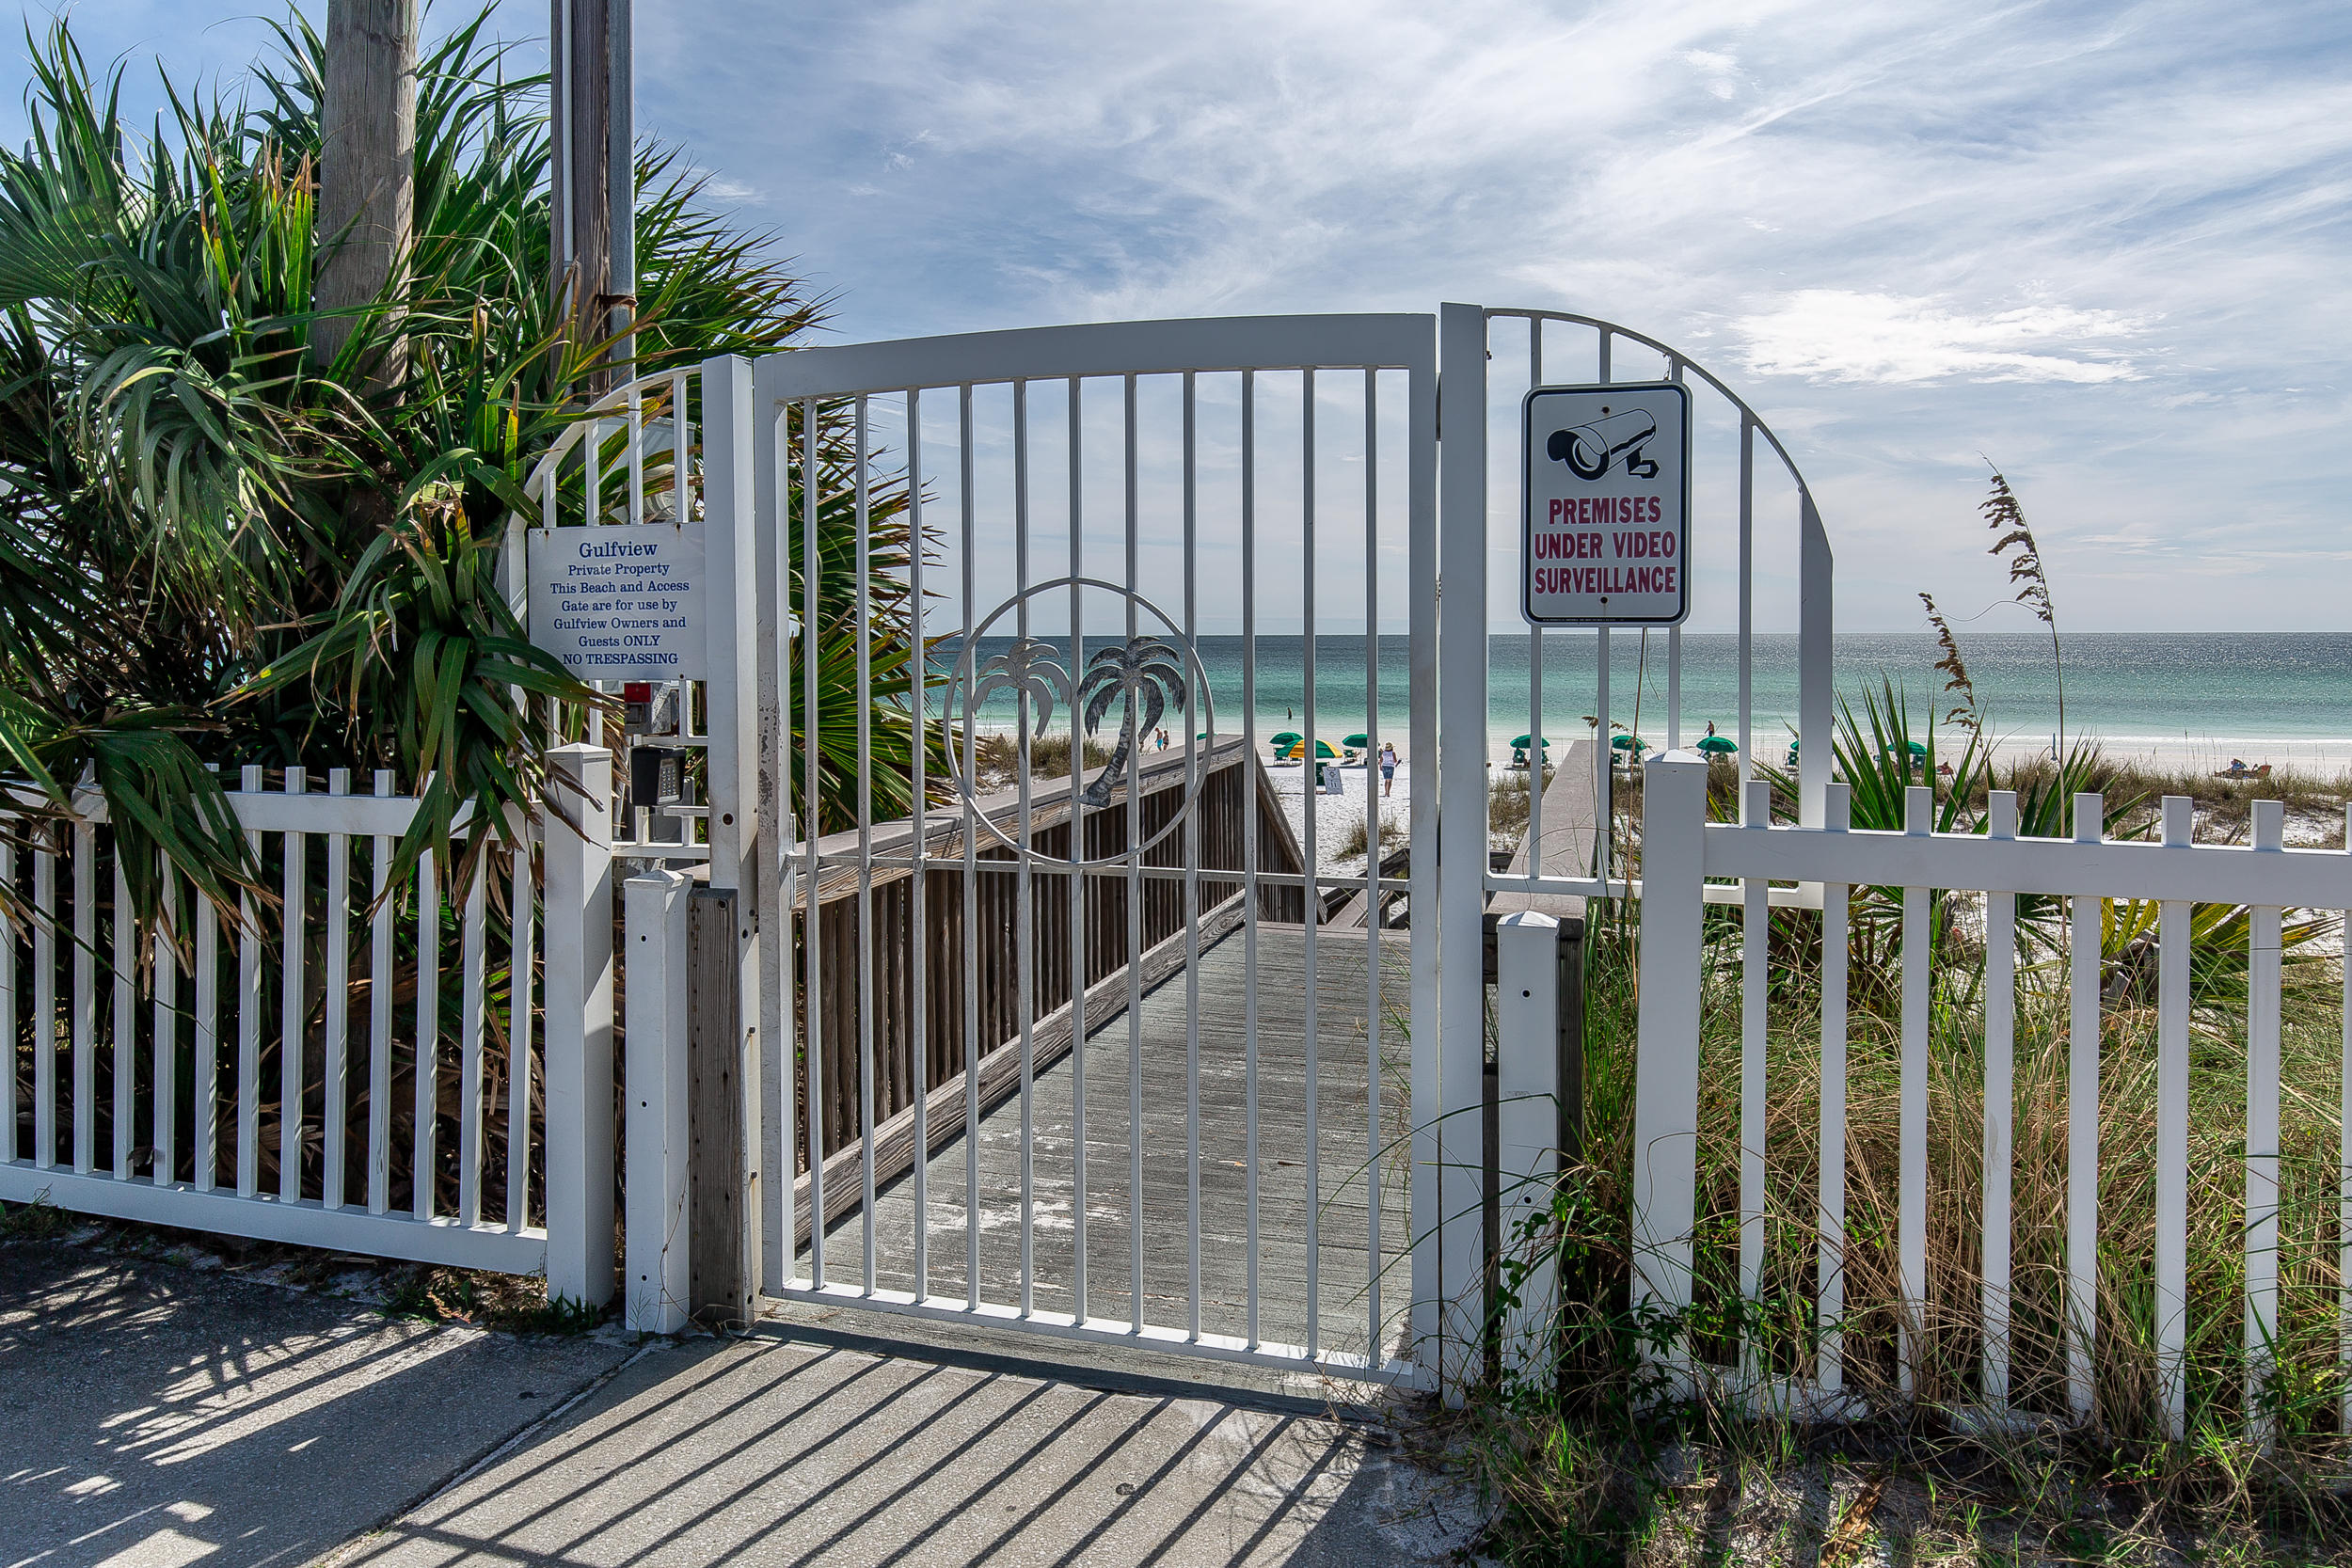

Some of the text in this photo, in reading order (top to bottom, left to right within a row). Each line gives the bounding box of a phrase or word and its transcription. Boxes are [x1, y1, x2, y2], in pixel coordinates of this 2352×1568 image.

[1549, 496, 1661, 525] PREMISES
[580, 541, 658, 558] Gulfview
[1534, 531, 1676, 559] UNDER VIDEO
[568, 562, 670, 577] Private Property
[550, 580, 690, 594] This Beach and Access
[1534, 566, 1677, 594] SURVEILLANCE
[562, 599, 677, 611] Gate are for use by
[554, 617, 686, 629] Gulfview Owners and
[579, 635, 660, 646] Guests ONLY
[564, 653, 678, 664] NO TRESPASSING
